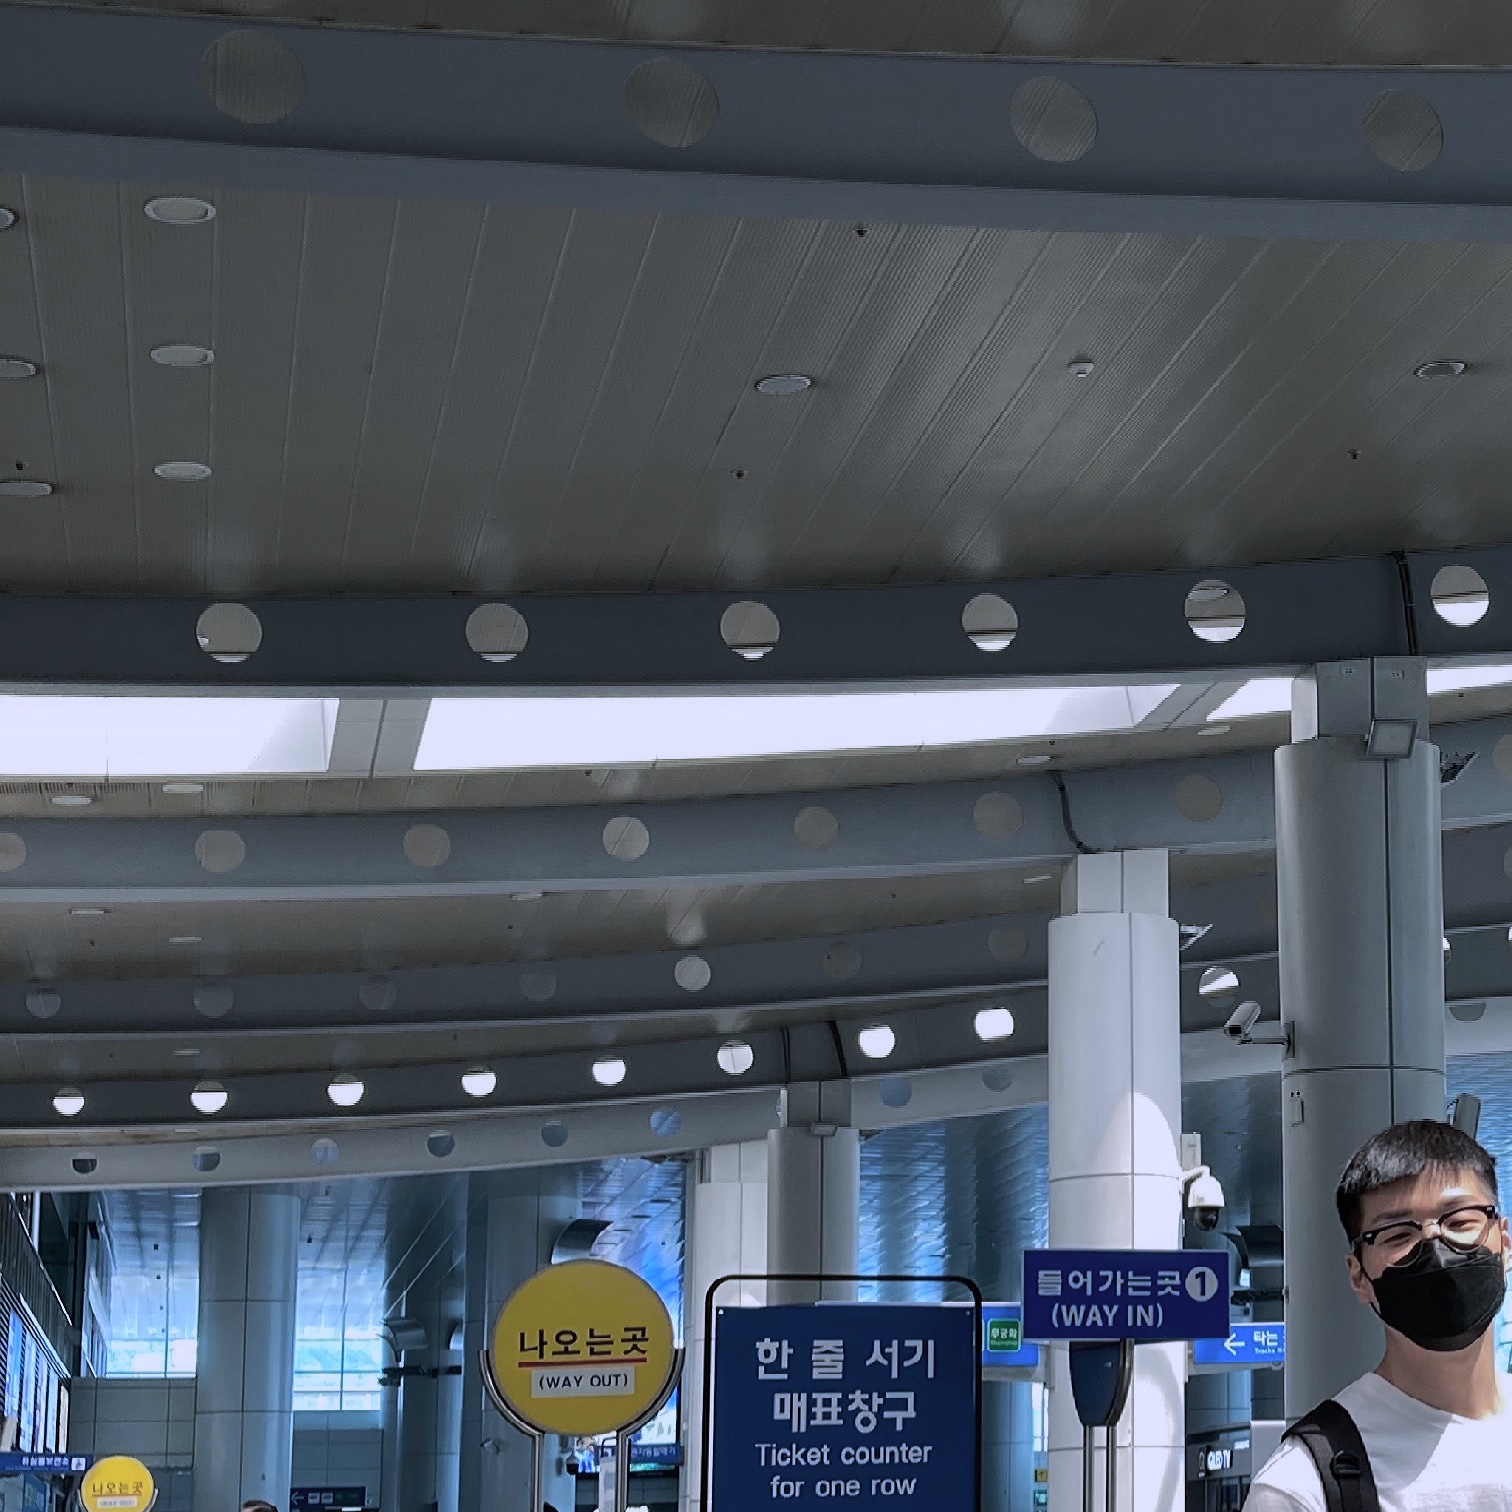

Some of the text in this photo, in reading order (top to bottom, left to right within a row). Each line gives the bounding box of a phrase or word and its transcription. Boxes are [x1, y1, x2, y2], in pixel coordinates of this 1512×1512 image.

[1038, 1270, 1181, 1296] 들어가는곳
[1052, 1303, 1164, 1328] (WAY IN)
[519, 1327, 649, 1359] 나오는곳
[756, 1338, 934, 1379] 한 줄 서기
[539, 1373, 628, 1389] (WAY OUT)
[774, 1390, 916, 1433] 매표창구
[755, 1443, 932, 1466] Ticket counter
[770, 1476, 916, 1498] for one row
